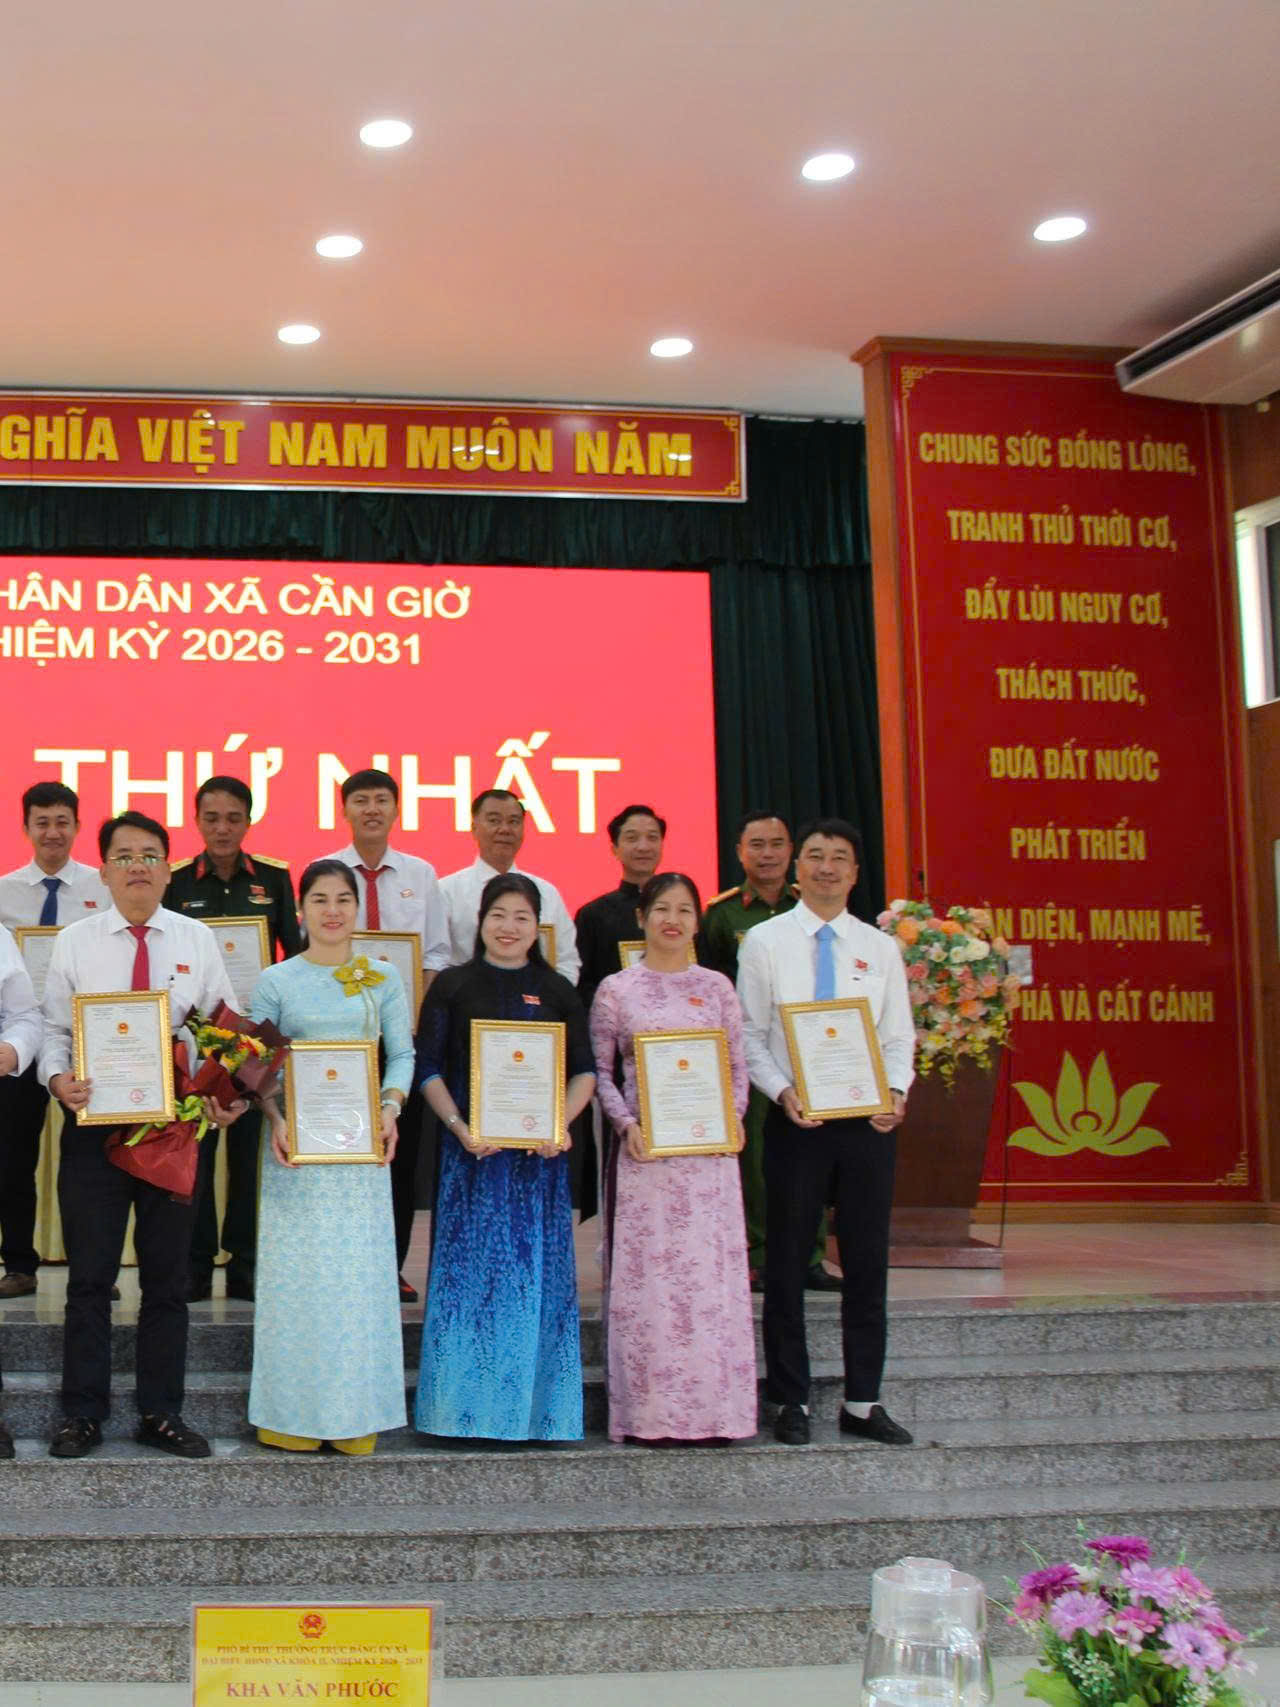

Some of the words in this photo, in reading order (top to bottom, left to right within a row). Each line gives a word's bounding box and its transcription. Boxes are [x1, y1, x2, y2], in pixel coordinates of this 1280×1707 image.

[137, 409, 245, 473] VIỆT
[269, 421, 387, 468] NAM
[406, 416, 554, 473] MUÔN
[575, 420, 691, 477] NĂM
[920, 432, 999, 465] CHUNG
[1005, 430, 1052, 467] SỨC
[947, 509, 1024, 543] TRANH
[1029, 505, 1074, 544] THỦ
[1080, 509, 1132, 546] THỜI
[1138, 515, 1177, 552] CƠ,
[96, 573, 192, 614] DÂN
[204, 577, 268, 615] XÃ
[278, 573, 374, 617] CẦN
[386, 580, 471, 619] GIỜ
[964, 576, 1011, 620] ĐẨY
[1017, 584, 1054, 621] LÙI
[1060, 592, 1122, 623] NGUY
[1129, 592, 1168, 629] CƠ,
[108, 620, 170, 660] KỲ
[181, 628, 285, 662] 2026
[296, 646, 313, 655] -
[324, 631, 422, 665] 2031
[996, 662, 1072, 700] THÁCH
[1078, 665, 1146, 706] THỨC,
[989, 744, 1039, 780] ĐƯA
[1043, 737, 1088, 780] ĐẤT
[1095, 743, 1160, 782] NƯỚC
[34, 733, 283, 828] THỨ
[318, 731, 621, 834] NHẤT
[1010, 821, 1071, 859] PHÁT
[1077, 816, 1146, 861] TRIỂN
[1020, 902, 1083, 947] DIỆN,
[1089, 909, 1161, 948] MẠNH
[1059, 983, 1091, 1021] VÀ
[1098, 978, 1142, 1021] CẤT
[1148, 984, 1215, 1022] CÁNH
[226, 1682, 272, 1698] KHA
[277, 1679, 319, 1697] VĂN
[325, 1678, 400, 1698] PHƯỚC
